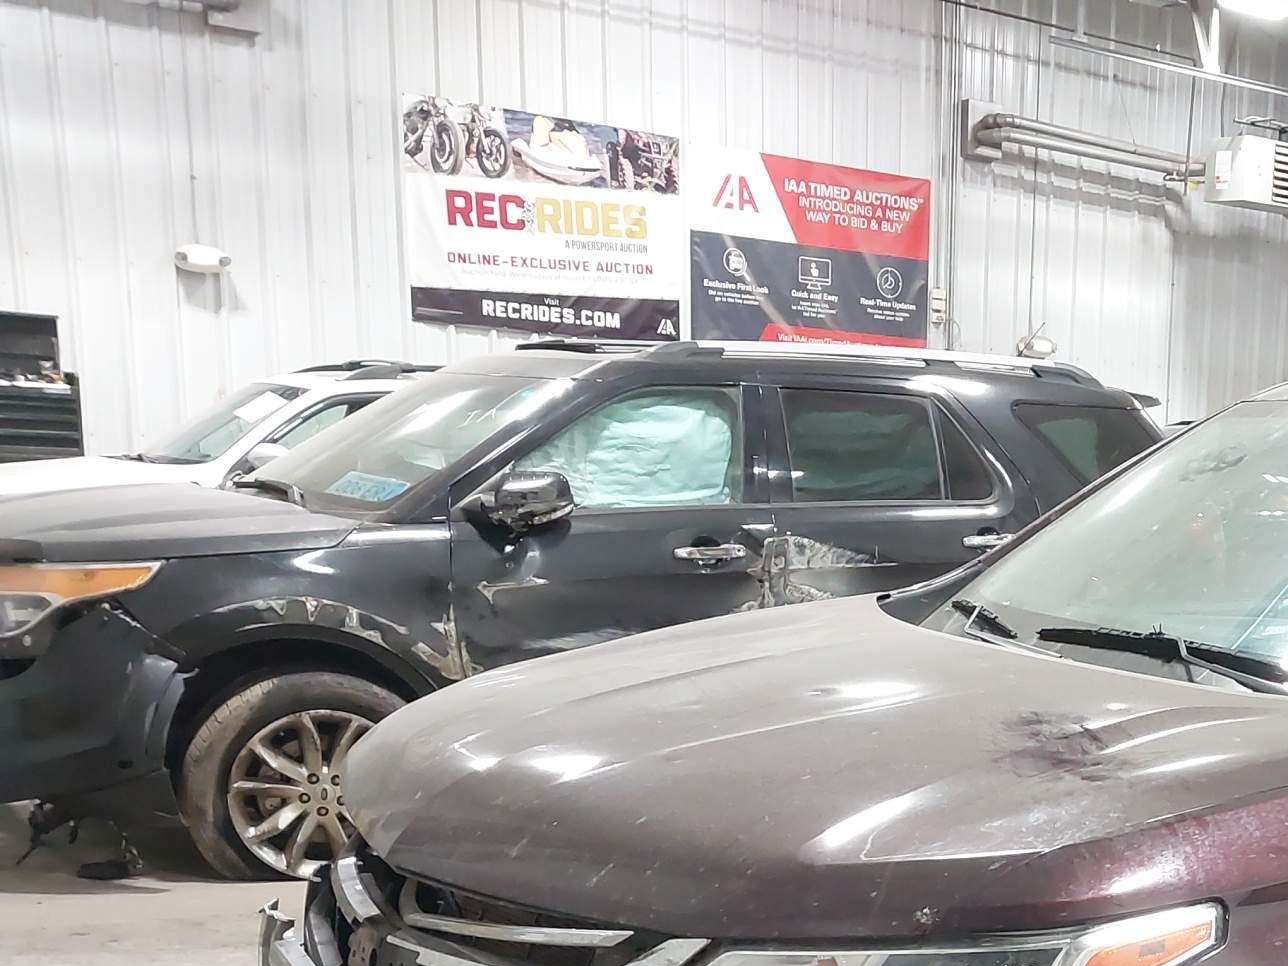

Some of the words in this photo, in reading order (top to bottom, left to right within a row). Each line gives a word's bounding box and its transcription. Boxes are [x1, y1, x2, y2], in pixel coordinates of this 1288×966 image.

[784, 178, 807, 194] IAA
[808, 181, 850, 200] TIMED
[445, 189, 526, 231] REC
[535, 197, 648, 239] RIDES
[799, 197, 873, 217] INTRODUCING
[874, 207, 883, 218] A
[886, 209, 910, 223] NEW
[805, 209, 831, 224] WAY
[833, 213, 848, 226] TO
[850, 216, 868, 230] BID
[870, 219, 879, 231] &
[881, 220, 903, 234] BUY
[571, 240, 618, 253] POWERSPORT
[619, 243, 648, 254] AUCTION
[447, 252, 590, 272] ONLINE-EXCLUSIVE
[596, 262, 653, 275] AUCTION
[544, 297, 559, 306] Visit
[810, 292, 822, 300] and
[481, 299, 621, 329] RECRIDES.COM
